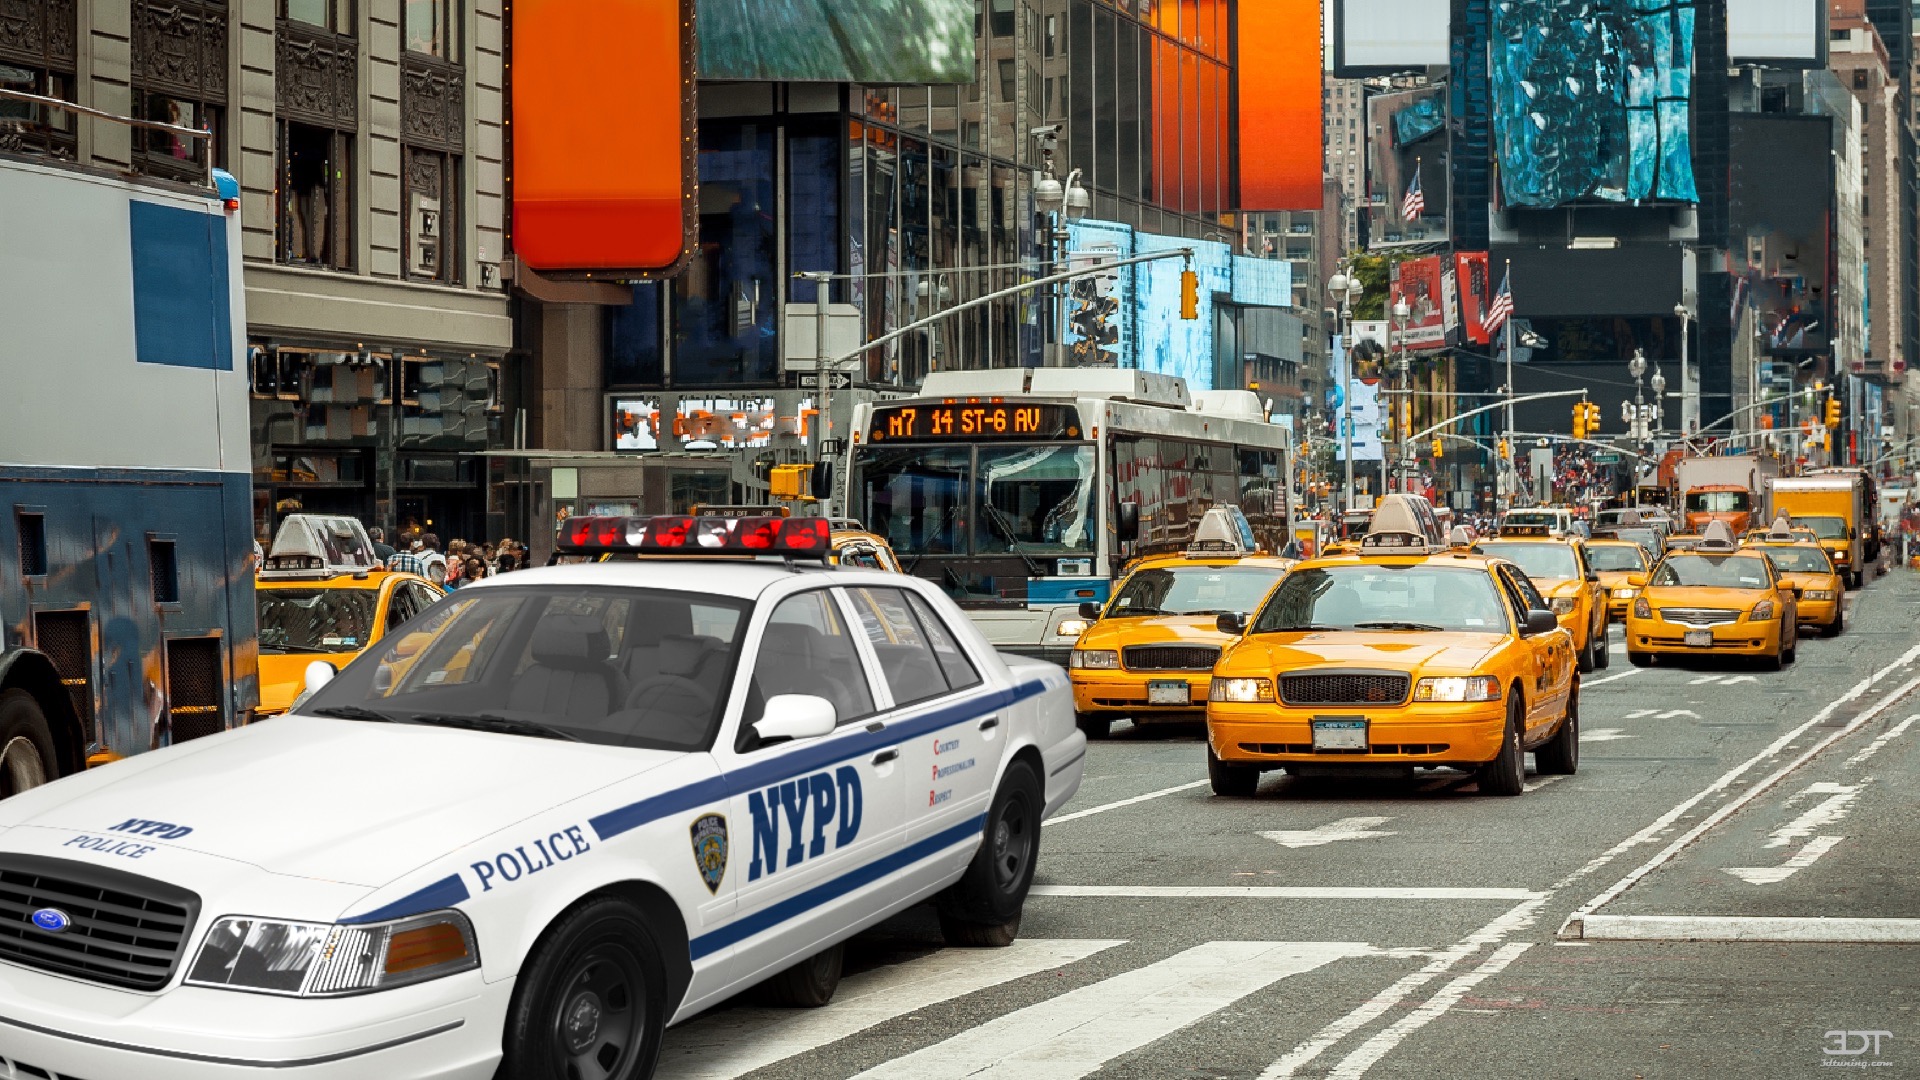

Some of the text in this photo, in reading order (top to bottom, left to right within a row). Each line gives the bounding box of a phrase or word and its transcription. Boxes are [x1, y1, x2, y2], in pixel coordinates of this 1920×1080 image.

[931, 409, 953, 434] 14
[962, 408, 1006, 433] ST-6
[1014, 408, 1040, 432] AV
[107, 818, 193, 839] NYPD
[748, 765, 863, 882] NYPD
[62, 835, 157, 858] POLICE
[470, 825, 591, 892] POLICE
